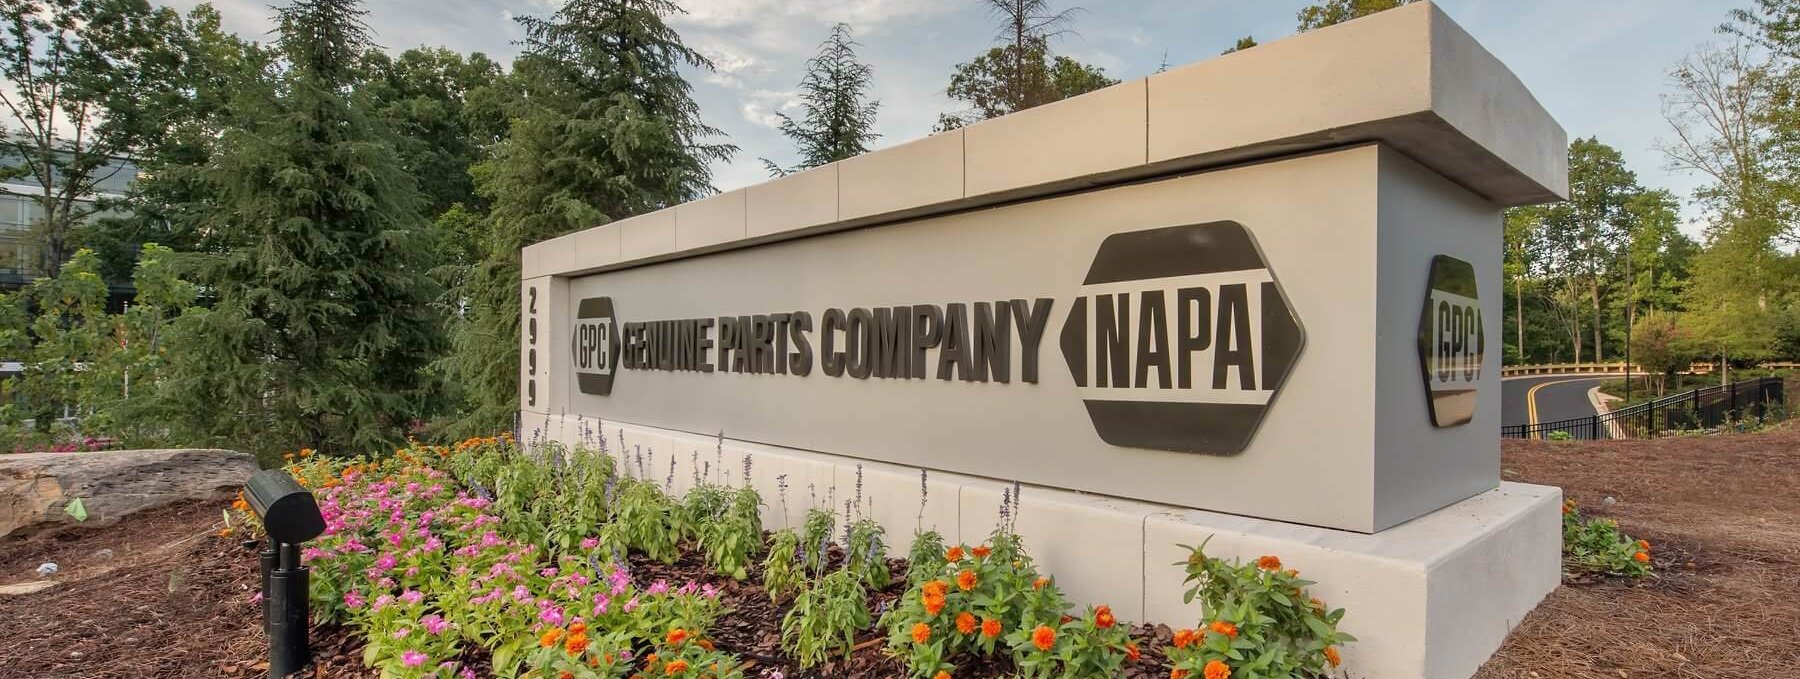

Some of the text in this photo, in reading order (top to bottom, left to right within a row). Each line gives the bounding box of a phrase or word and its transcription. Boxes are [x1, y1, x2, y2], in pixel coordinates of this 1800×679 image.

[528, 287, 537, 407] 2999
[580, 322, 606, 370] GPC
[622, 298, 1054, 384] GENUINE PARTS COMPANY
[1095, 283, 1257, 391] NAPA
[1438, 300, 1475, 383] GPC
